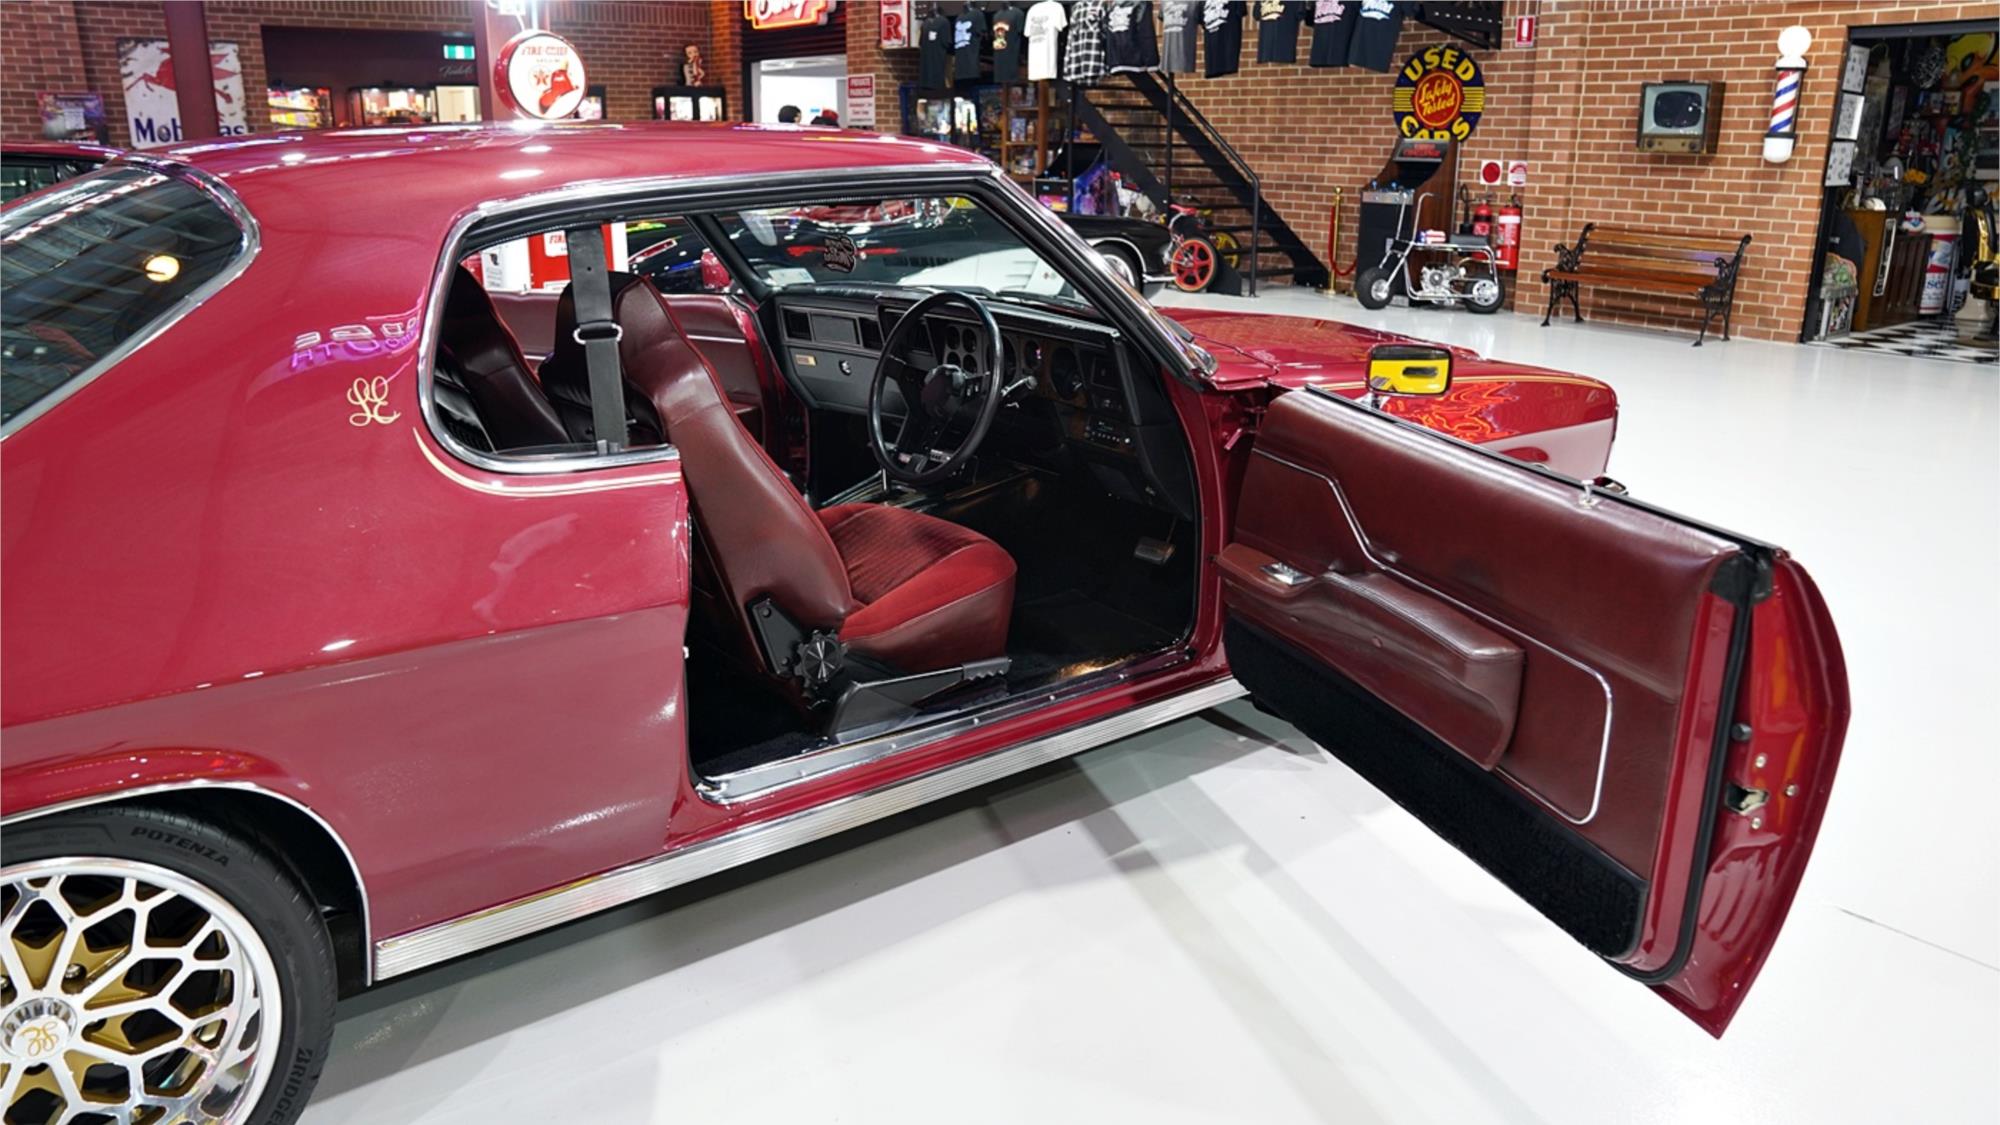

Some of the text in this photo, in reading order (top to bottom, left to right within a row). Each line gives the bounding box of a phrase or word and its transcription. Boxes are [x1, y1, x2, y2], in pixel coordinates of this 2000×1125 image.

[1404, 47, 1475, 81] USED
[1419, 80, 1453, 104] Safety
[1422, 93, 1456, 116] Tested
[131, 826, 230, 868] POTENZA
[263, 1047, 313, 1125] BRIDGE
